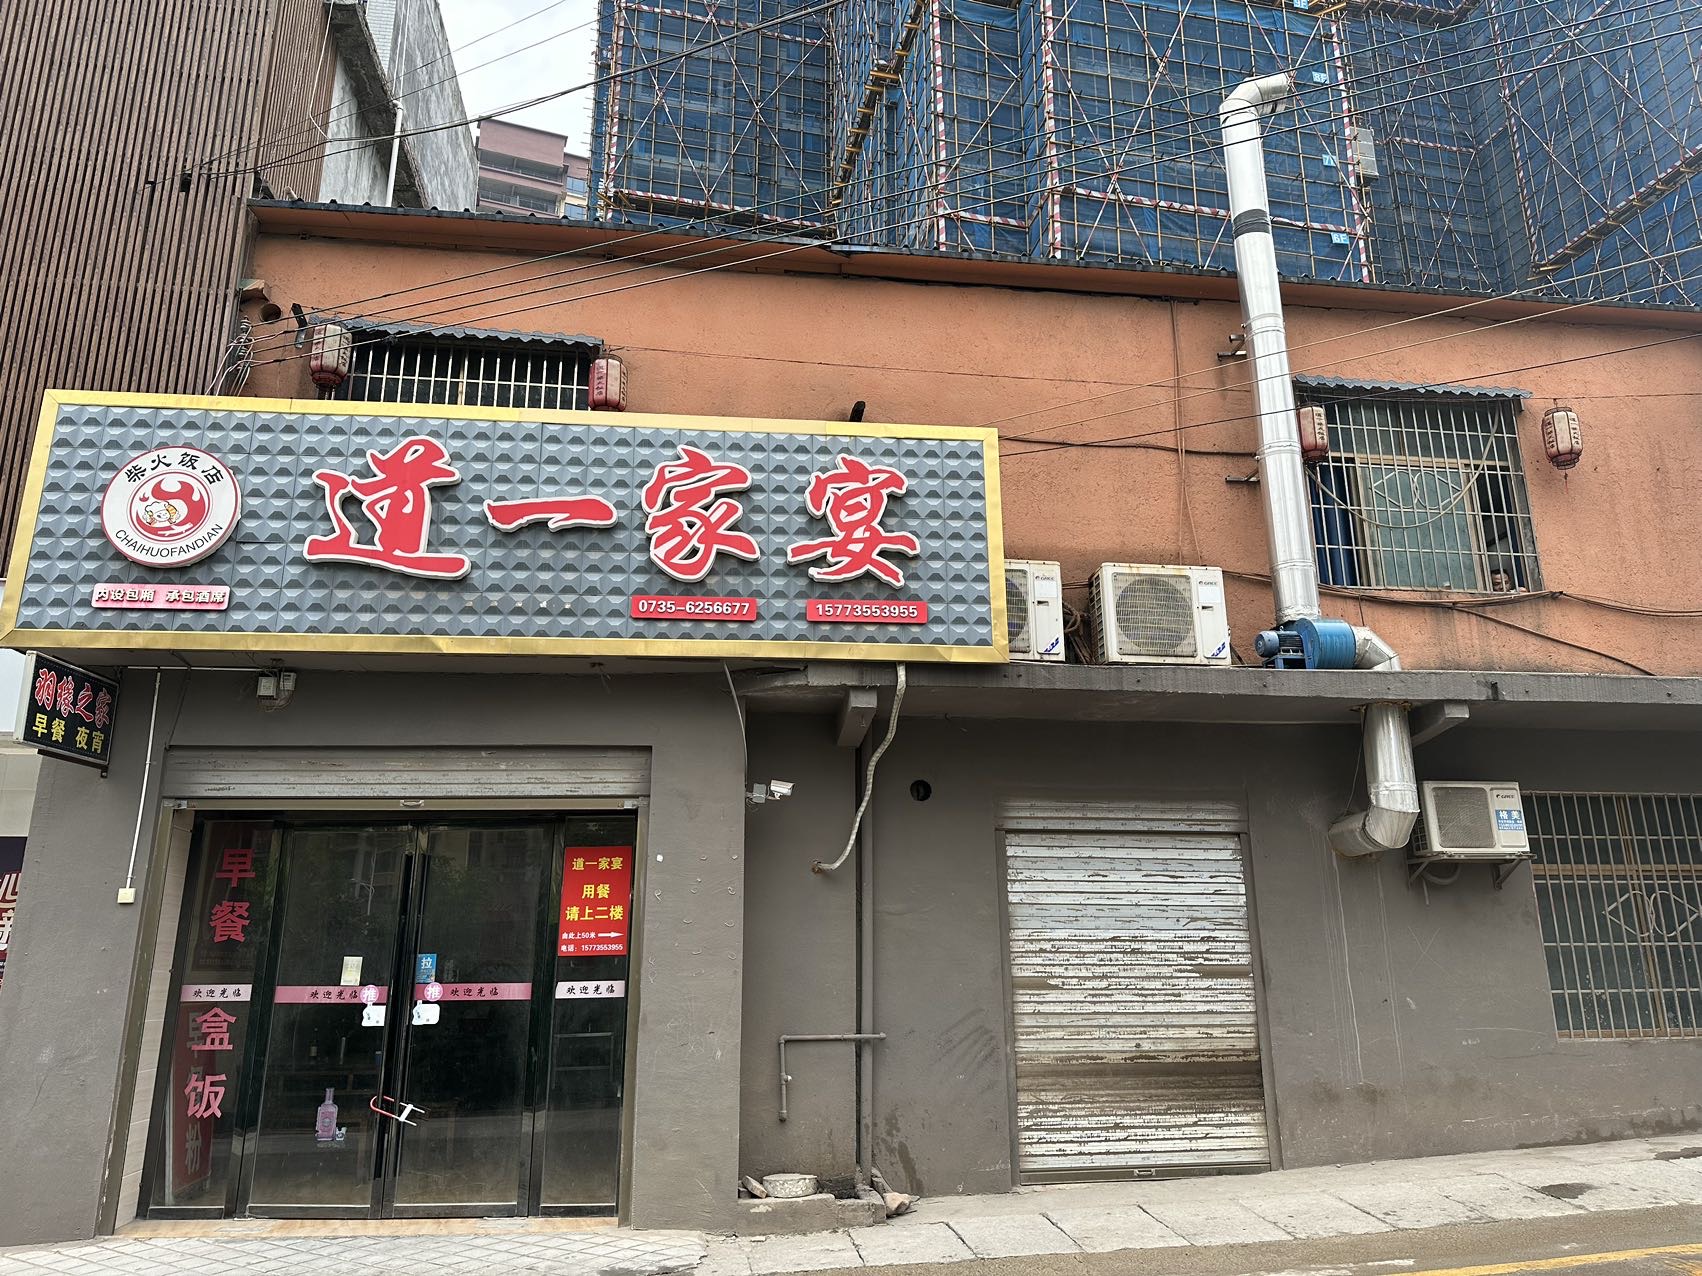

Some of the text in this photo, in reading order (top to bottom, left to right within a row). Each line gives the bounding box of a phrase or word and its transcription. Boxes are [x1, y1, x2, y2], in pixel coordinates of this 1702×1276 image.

[125, 452, 224, 485] 柴火饭店
[304, 435, 921, 588] 道一家宴
[115, 523, 224, 558] CHAIHUOFANDIAN
[95, 587, 226, 604] 内设包厢 承包酒席
[639, 599, 750, 616] 0735-6256677
[816, 603, 918, 618] 15773553955
[33, 713, 104, 753] 早餐 夜宵
[572, 857, 623, 870] 道一家宴
[210, 848, 257, 943] 早餐
[582, 884, 610, 898] 用餐
[565, 905, 623, 921] 请上二楼
[421, 957, 432, 969] 拉
[192, 987, 242, 998] 欢迎光临
[310, 989, 359, 1000] 欢迎光临
[362, 987, 377, 1003] 推
[426, 986, 442, 999] 推
[450, 987, 499, 998] 欢迎光临
[566, 983, 615, 995] 欢迎光临
[184, 1007, 237, 1119] 盒饭
